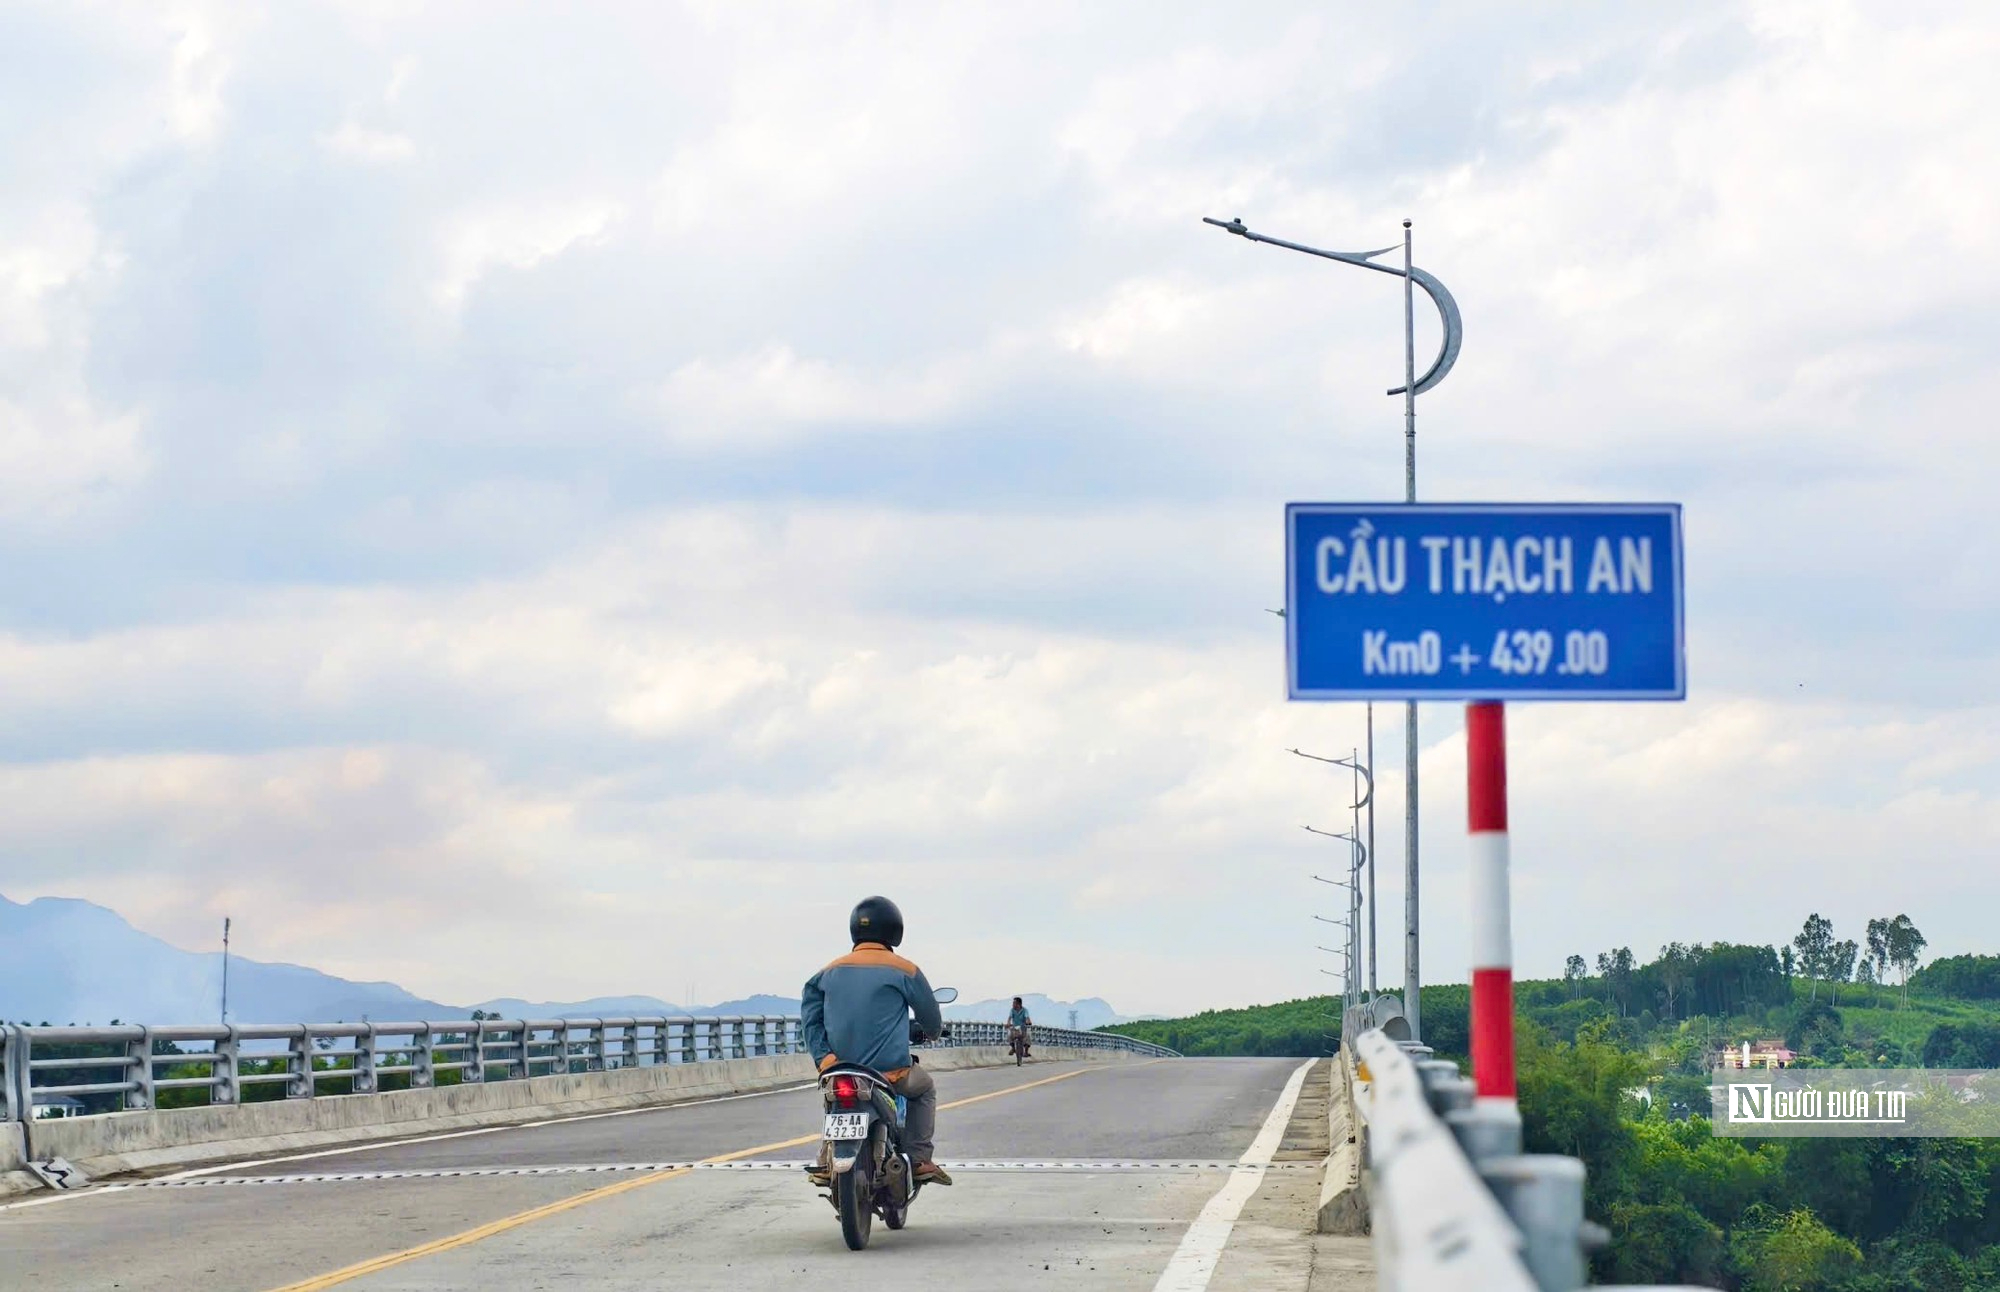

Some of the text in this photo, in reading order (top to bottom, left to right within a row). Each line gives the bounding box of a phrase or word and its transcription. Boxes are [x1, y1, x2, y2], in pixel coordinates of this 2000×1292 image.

[1316, 519, 1653, 604] CẦU THẠCH AN
[1450, 644, 1480, 674] +
[826, 1126, 865, 1137] 432.30
